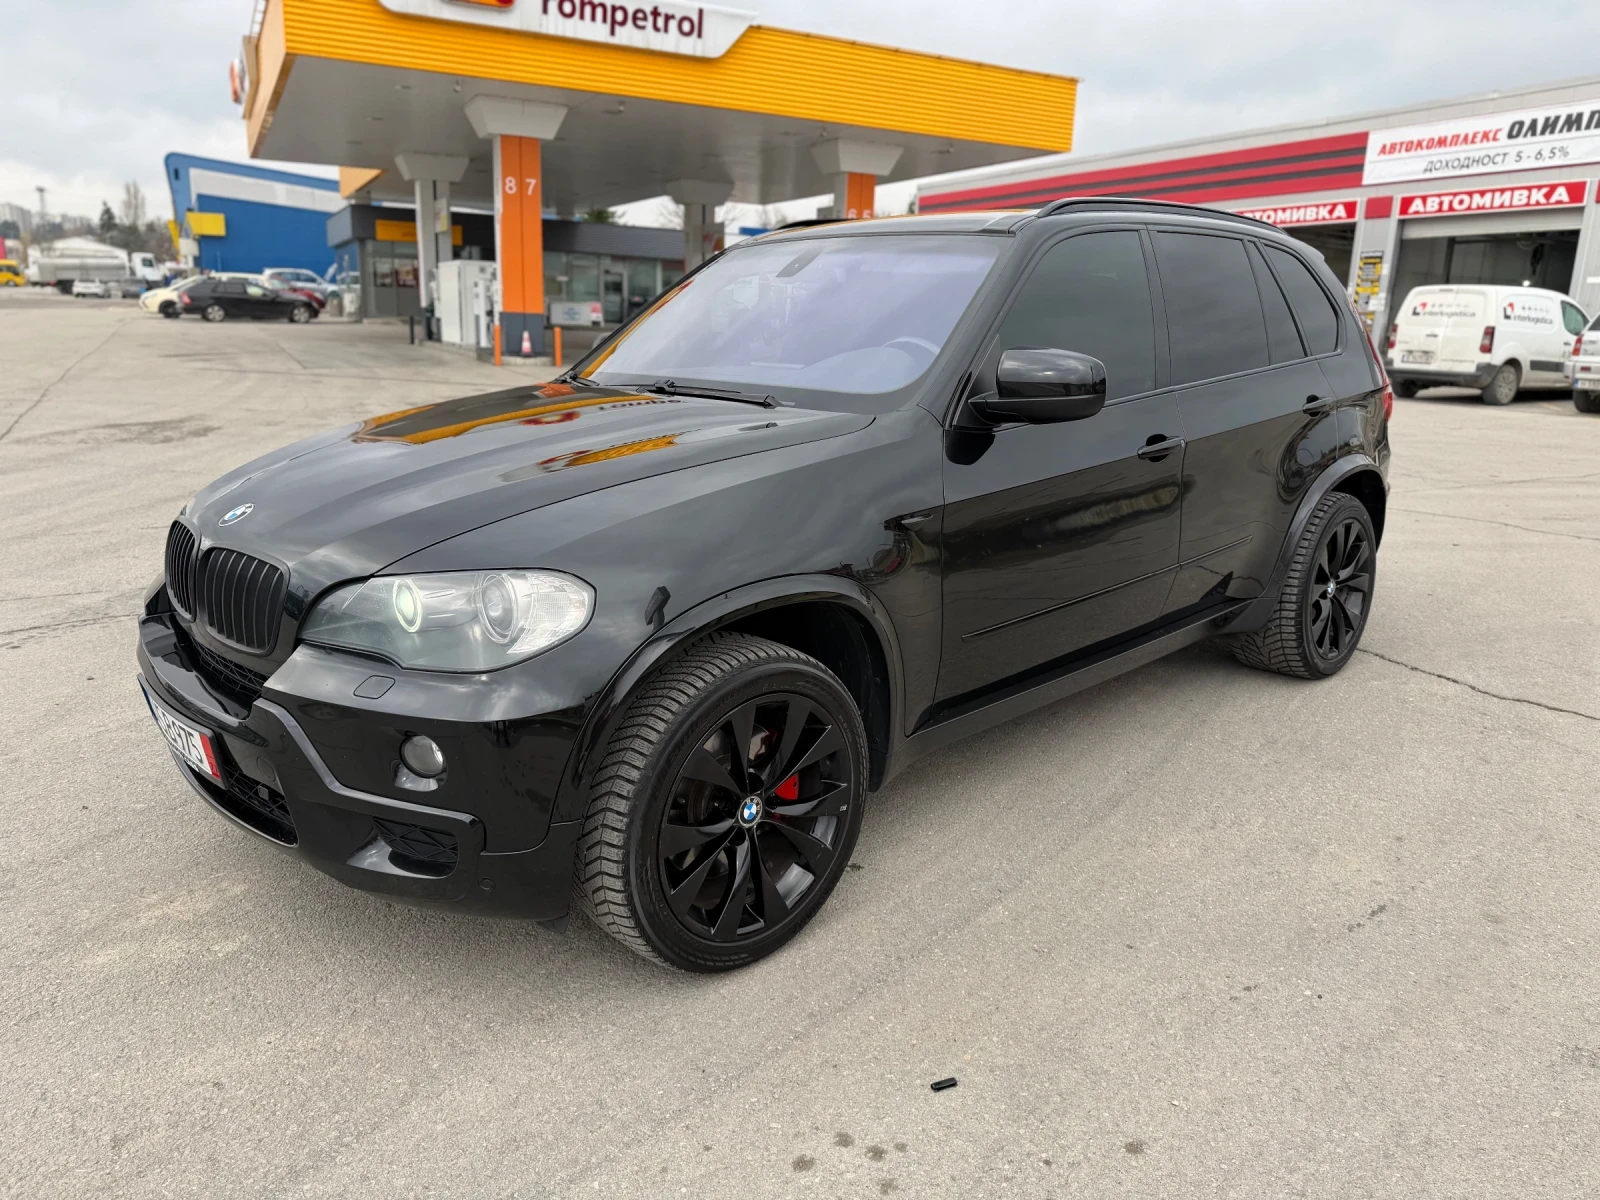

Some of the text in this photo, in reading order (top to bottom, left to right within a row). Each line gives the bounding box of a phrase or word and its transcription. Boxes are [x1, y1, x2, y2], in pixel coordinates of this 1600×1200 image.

[541, 0, 704, 39] rompetrol
[1377, 128, 1504, 156] АВТОКОМПЛЕКС
[1423, 152, 1509, 174] ДОХОДНОСТ
[1514, 151, 1523, 163] 5
[1535, 146, 1570, 162] 6,5%
[505, 176, 537, 196] 8 7
[1407, 186, 1570, 214] АВТОМИВКА
[1243, 203, 1347, 223] ТОМИВКА
